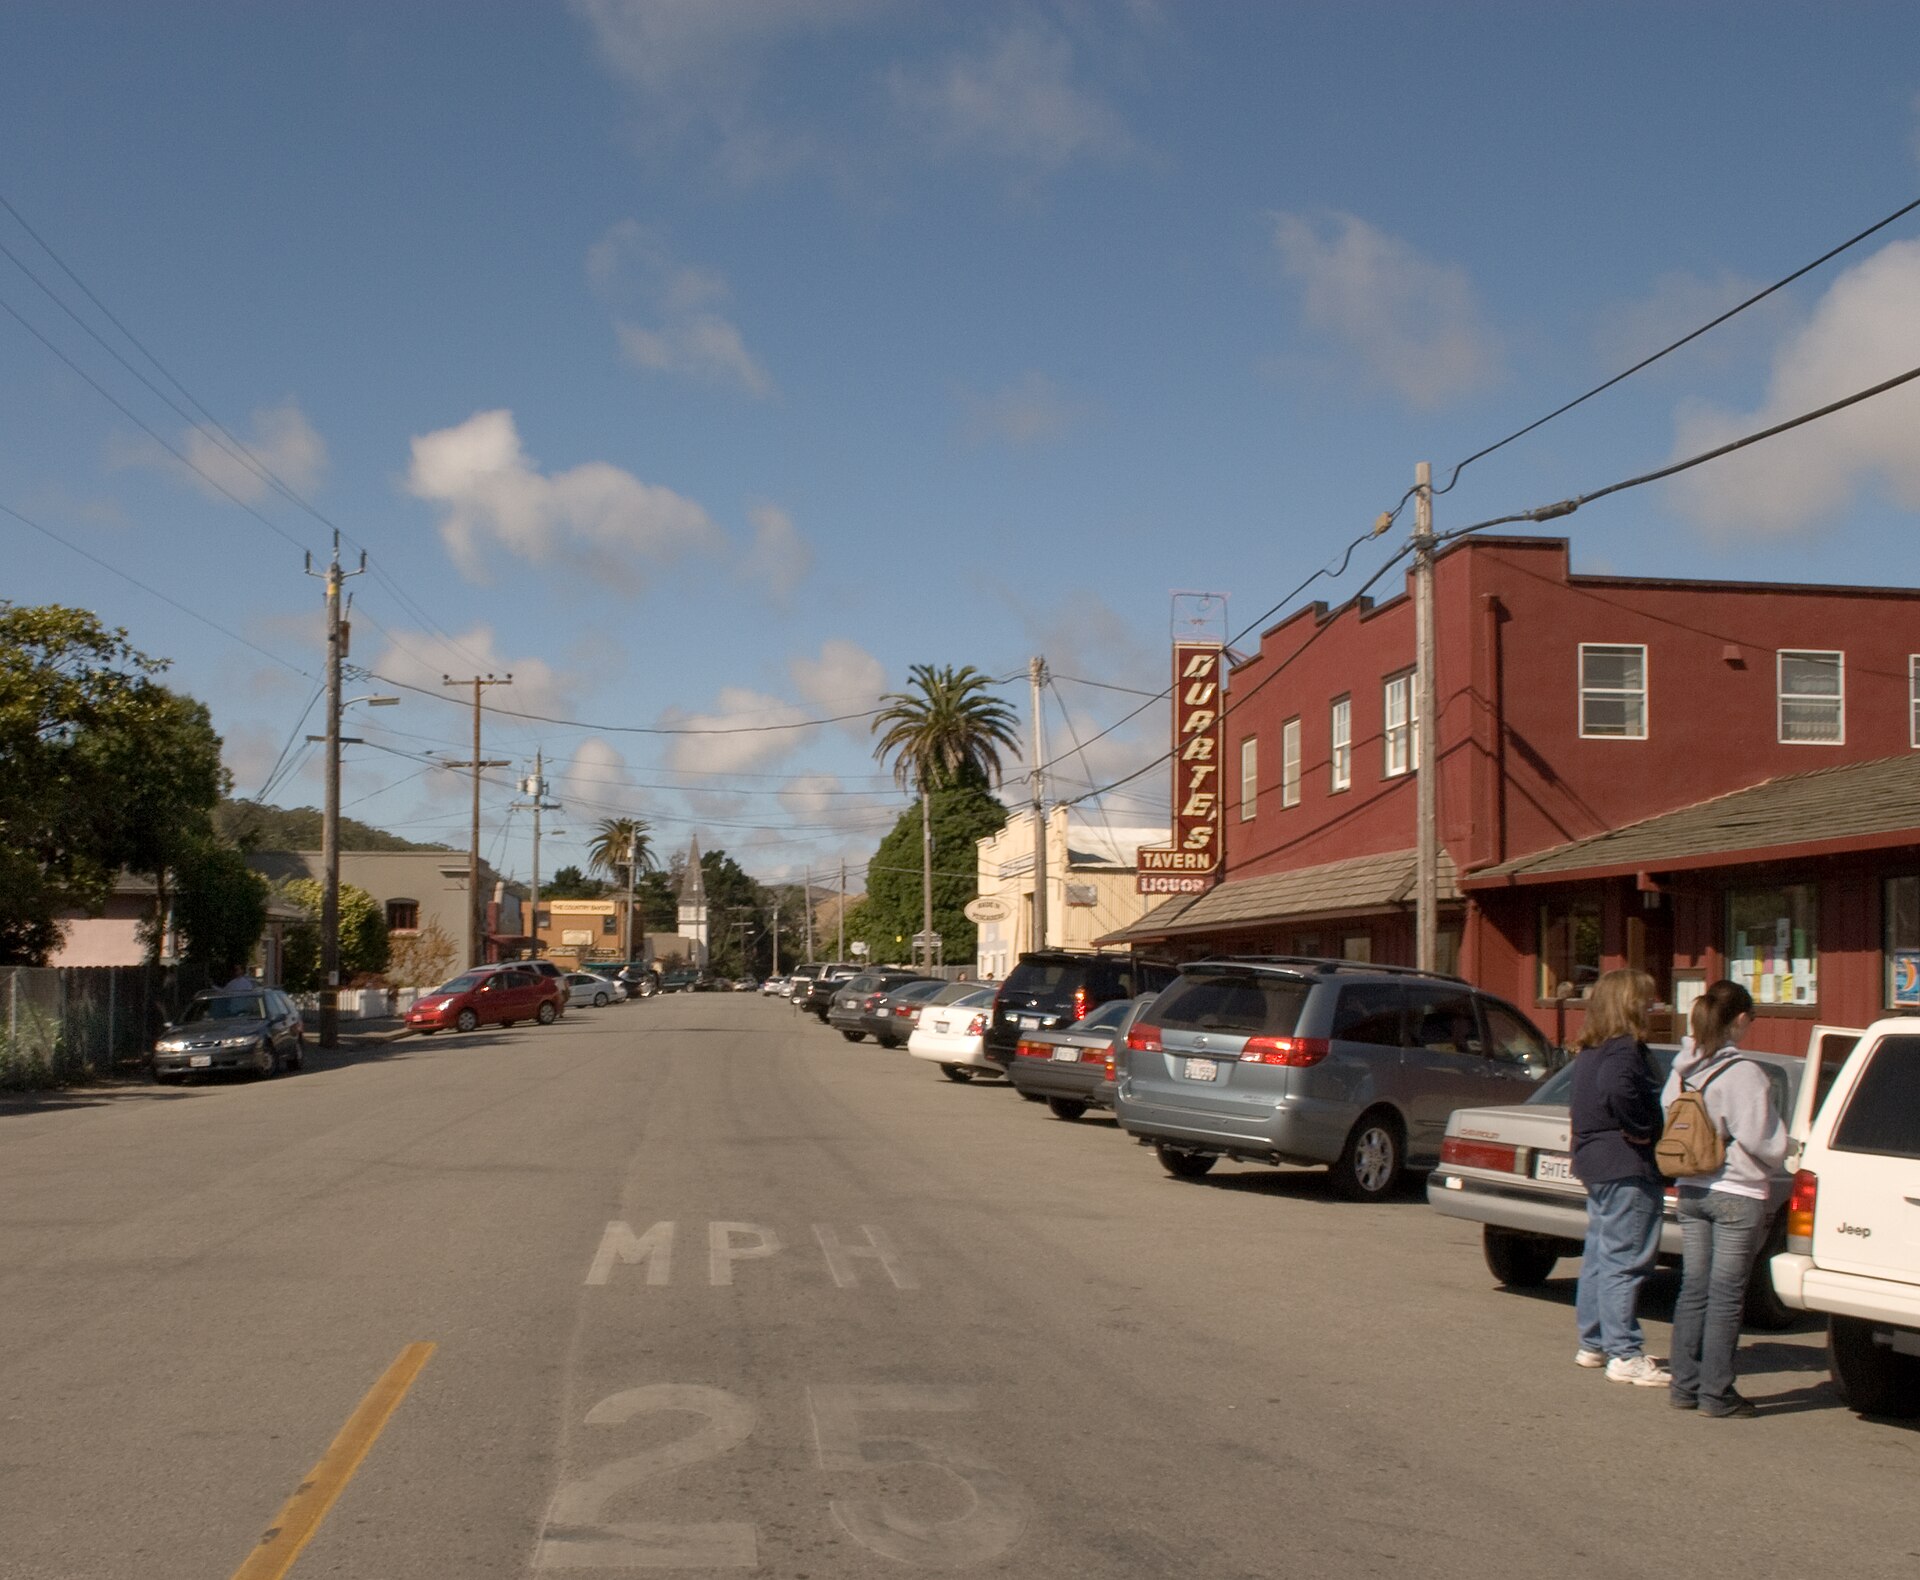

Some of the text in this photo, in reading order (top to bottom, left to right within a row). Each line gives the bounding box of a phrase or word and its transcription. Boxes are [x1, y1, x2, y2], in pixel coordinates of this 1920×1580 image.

[1182, 655, 1217, 849] DUARTE'S
[1142, 853, 1210, 869] TAVERN
[1141, 877, 1205, 893] LIQUOR
[1540, 1161, 1577, 1179] 5HTE
[1837, 1221, 1871, 1239] Jeep
[584, 1220, 920, 1289] MPH
[531, 1382, 1031, 1569] 25
